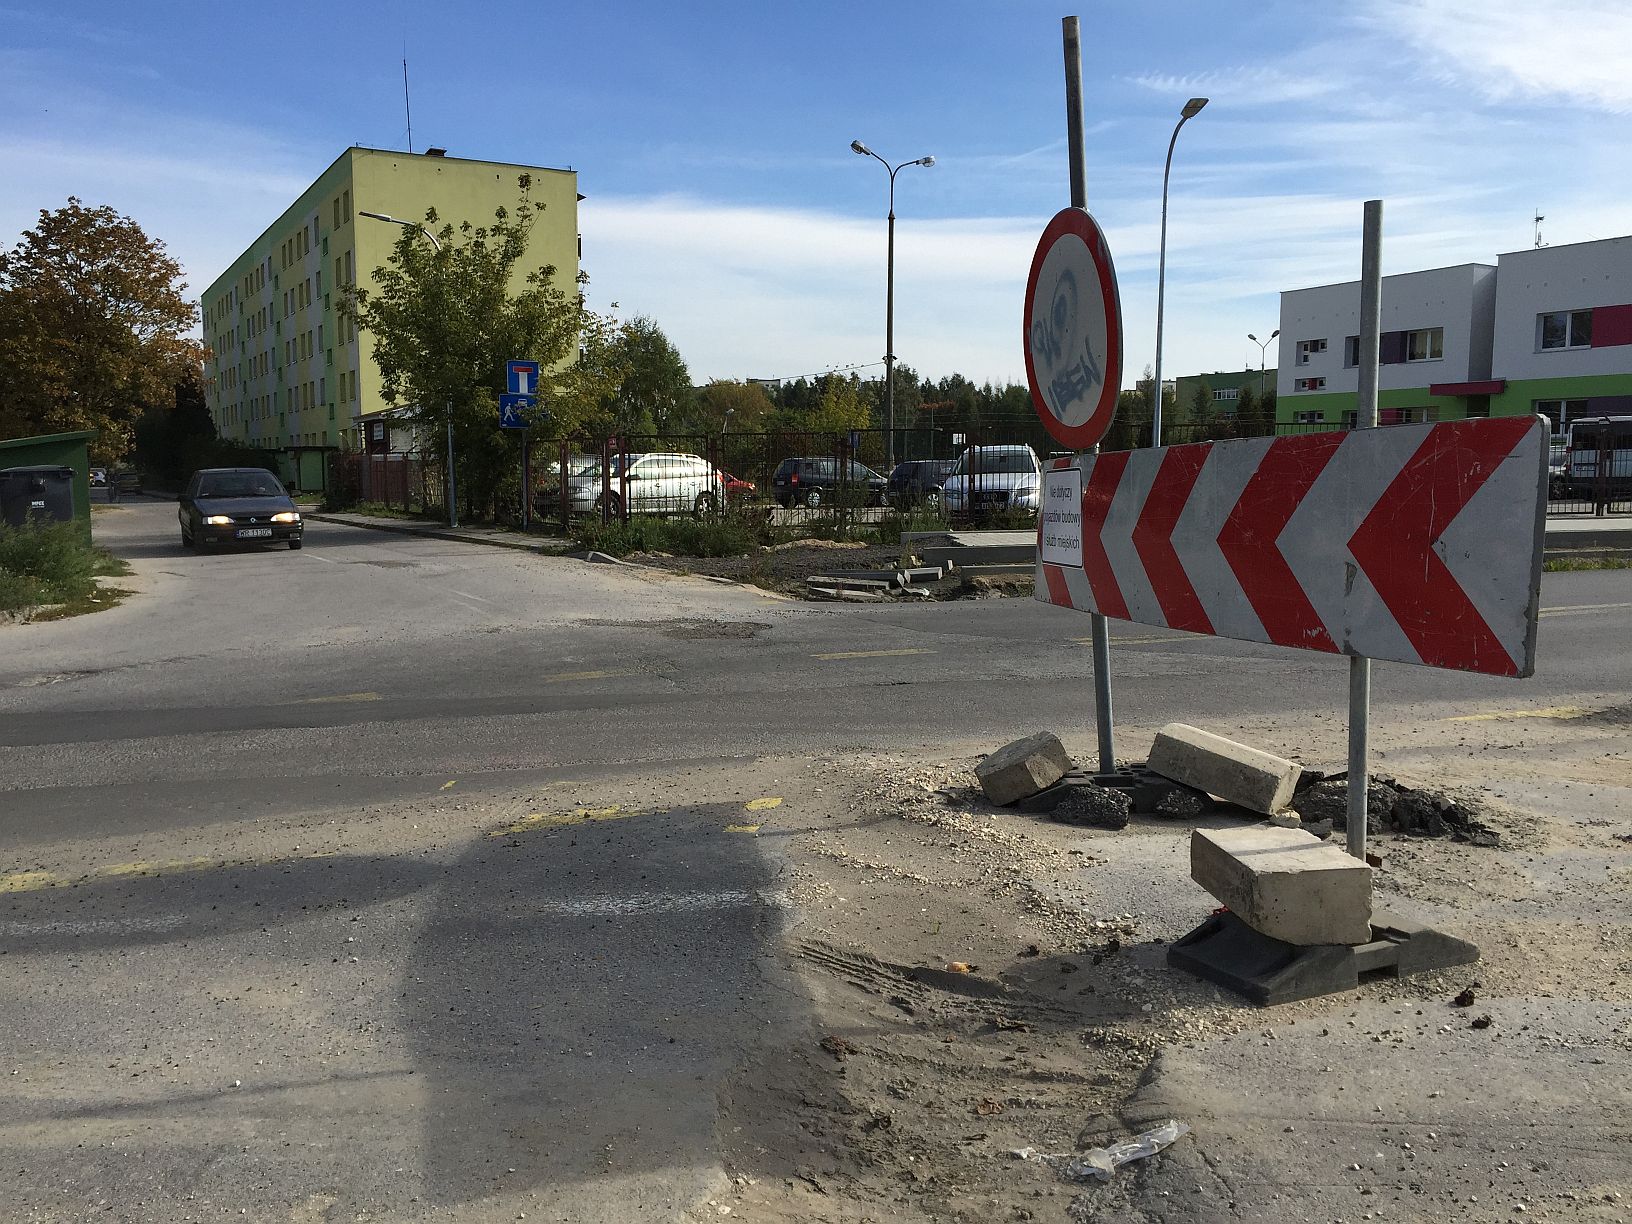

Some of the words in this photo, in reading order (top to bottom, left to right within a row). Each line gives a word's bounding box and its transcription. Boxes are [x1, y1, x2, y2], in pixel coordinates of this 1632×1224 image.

[1057, 485, 1072, 502] dotyczy
[1062, 510, 1081, 528] budowy
[1057, 534, 1080, 552] miejskich
